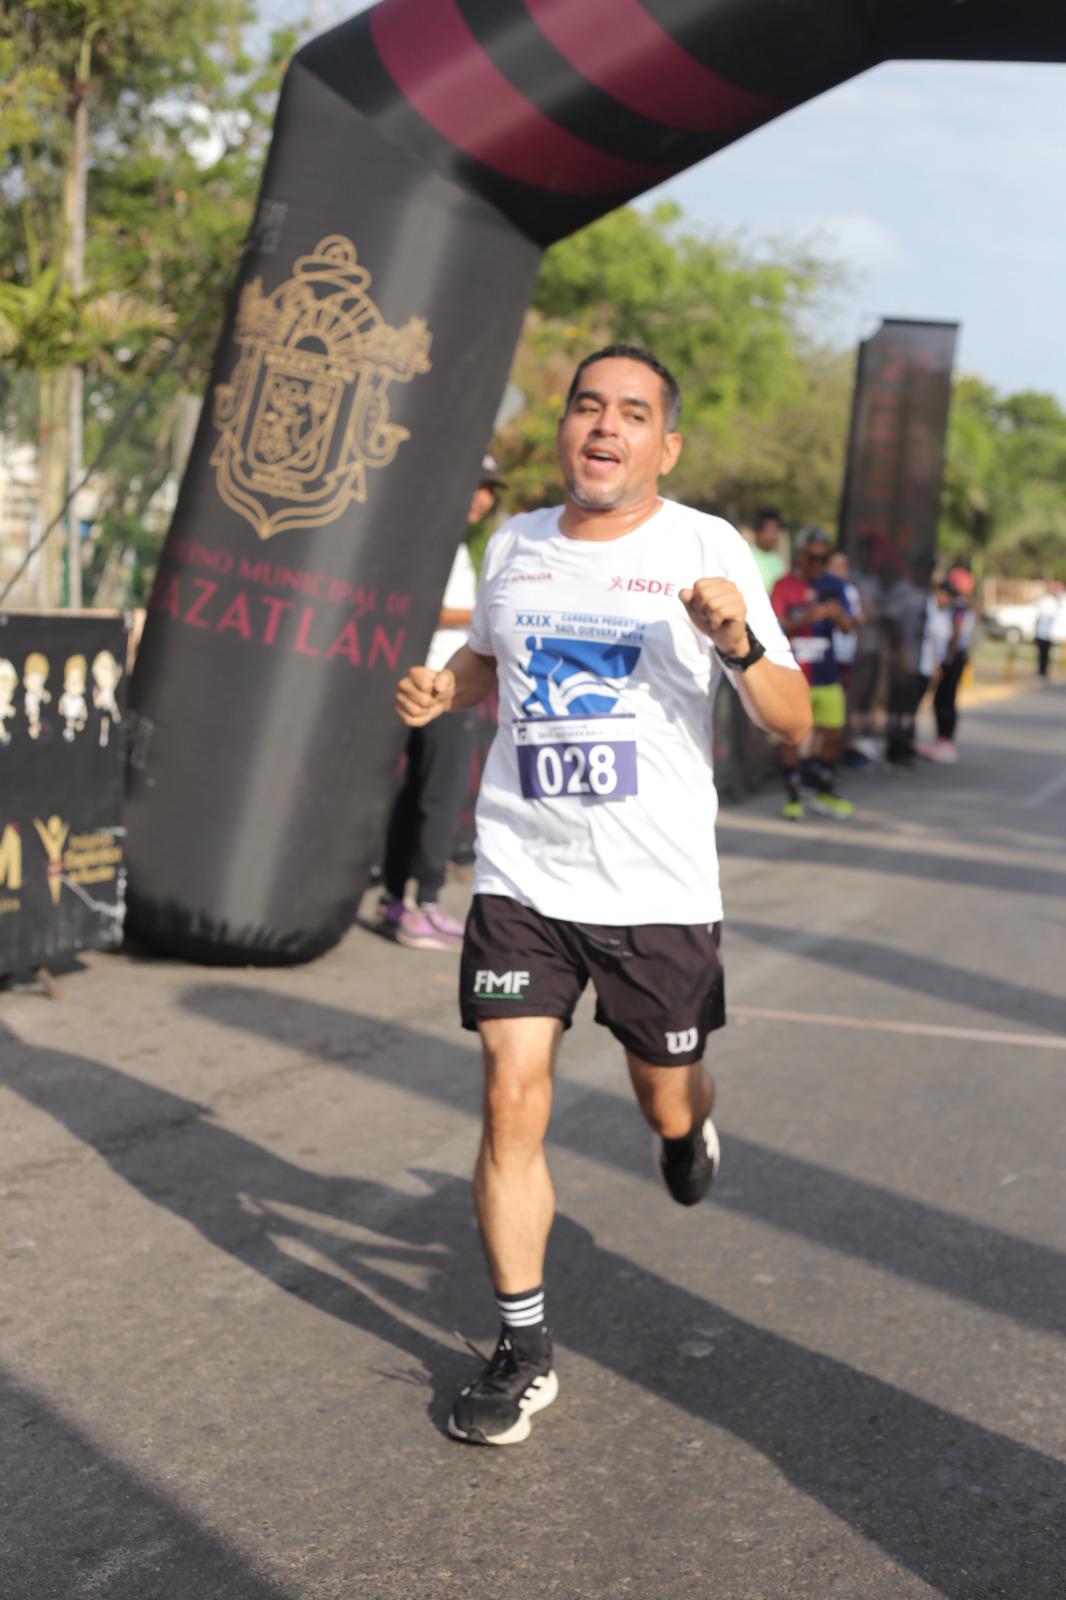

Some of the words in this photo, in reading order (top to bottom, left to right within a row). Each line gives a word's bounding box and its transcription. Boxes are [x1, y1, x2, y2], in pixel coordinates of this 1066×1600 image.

[238, 556, 379, 610] MUNICIPAL
[627, 579, 675, 598] ISDE
[515, 614, 552, 627] XXIX
[561, 612, 599, 624] CARRERA
[537, 745, 617, 795] 028
[474, 970, 529, 994] FMF
